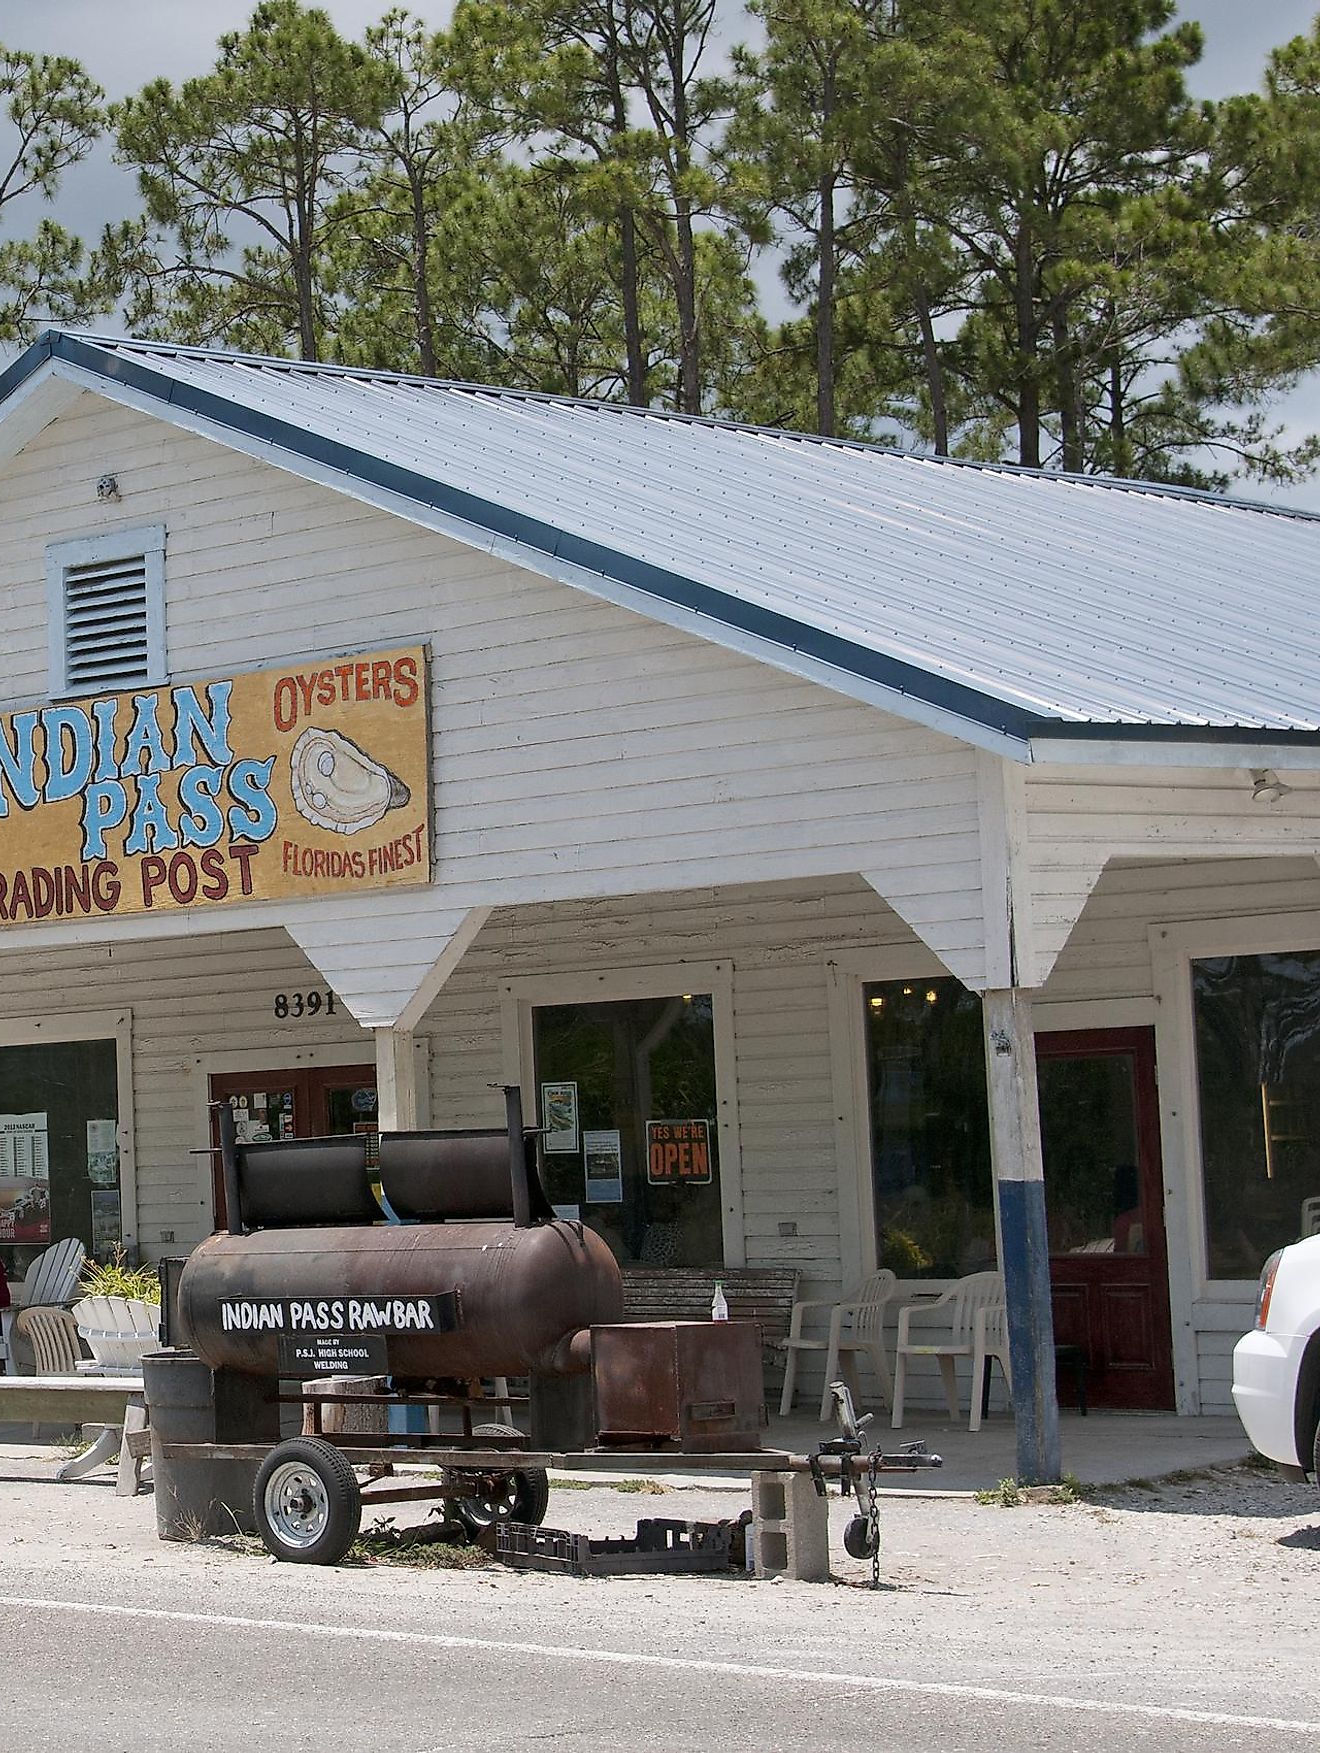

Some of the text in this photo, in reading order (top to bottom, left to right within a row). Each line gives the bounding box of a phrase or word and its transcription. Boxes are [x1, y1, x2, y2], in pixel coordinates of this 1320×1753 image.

[274, 657, 419, 733] OYSTERS
[79, 755, 278, 862] PASS
[283, 824, 424, 879] FLORIDAS FINEST
[142, 846, 259, 907] POST
[274, 990, 337, 1018] 8391
[651, 1126, 669, 1139] YES
[650, 1142, 708, 1175] OPEN
[221, 1303, 283, 1330] INDIAN
[290, 1300, 344, 1330] PASS
[296, 1348, 369, 1358] P.S.J. HIGH SCHOOL
[314, 1361, 348, 1370] WELDING
